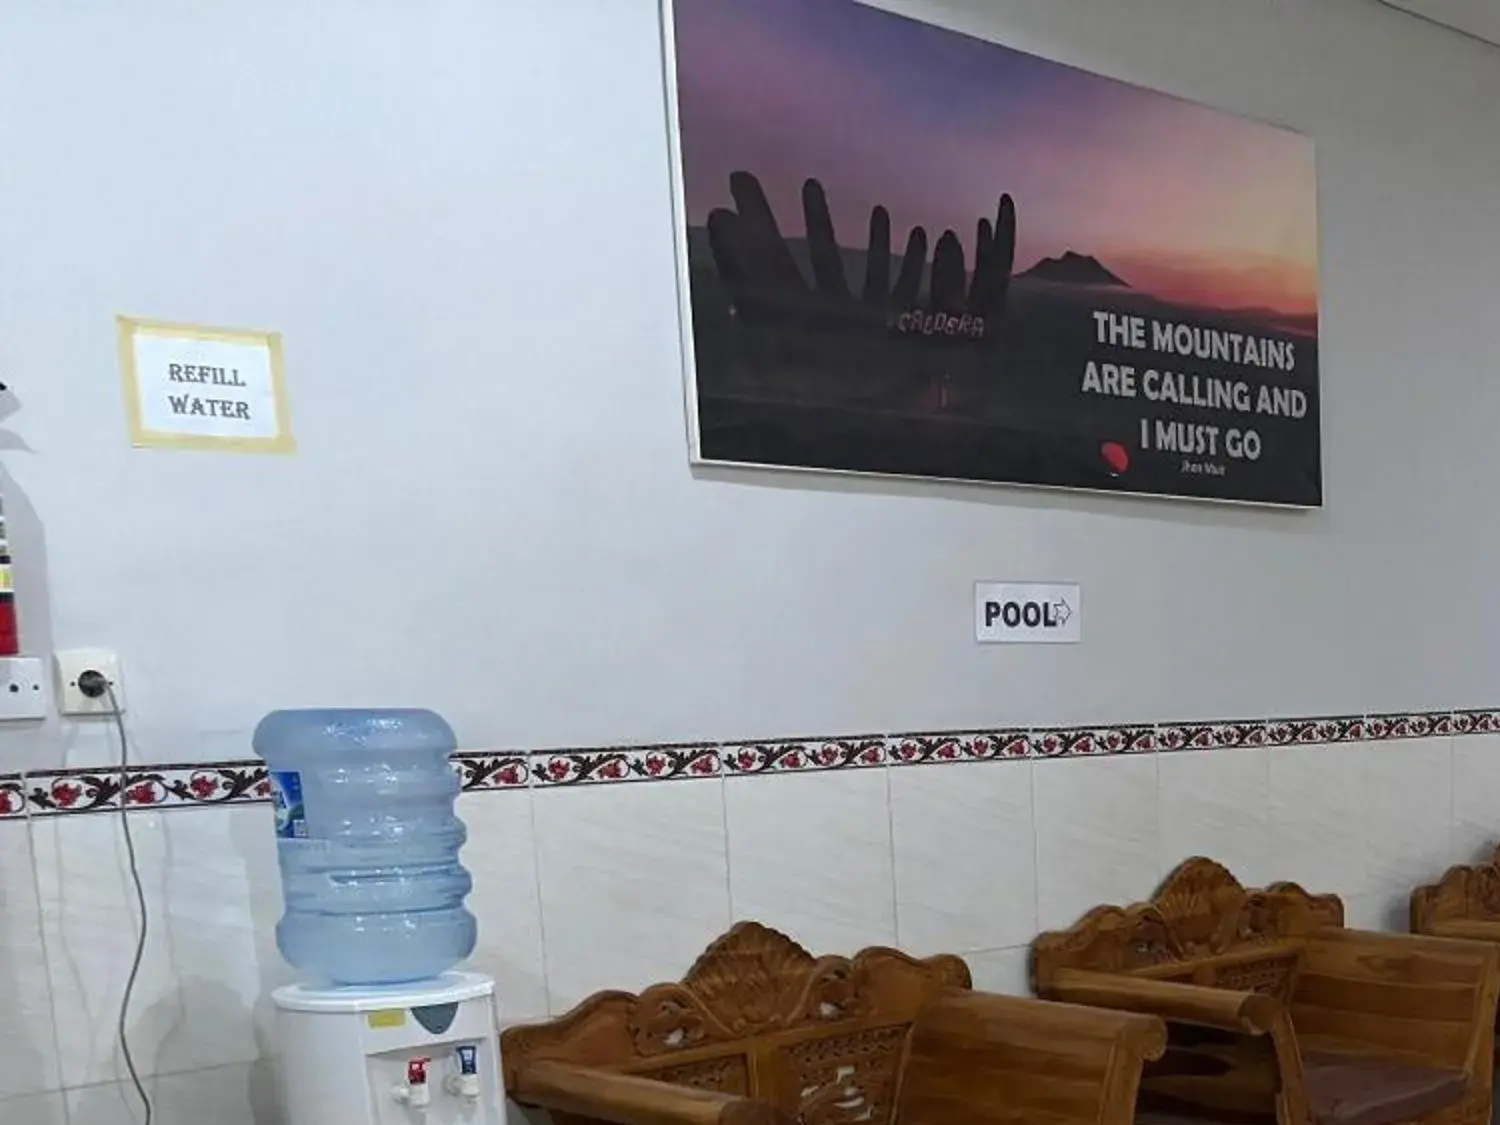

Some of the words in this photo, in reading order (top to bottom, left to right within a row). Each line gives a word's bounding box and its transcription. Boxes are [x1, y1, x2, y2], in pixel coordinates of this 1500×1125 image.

[1093, 311, 1146, 348] THE
[1152, 320, 1295, 371] MOUNTAINS
[168, 363, 247, 387] REFILL
[1081, 361, 1136, 397] ARE
[1142, 369, 1250, 412] CALLING
[1255, 385, 1307, 419] AND
[168, 394, 251, 420] WATER
[1140, 418, 1149, 449] I
[1155, 420, 1219, 455] MUST
[1225, 429, 1261, 460] GO
[985, 601, 1058, 628] POOL
